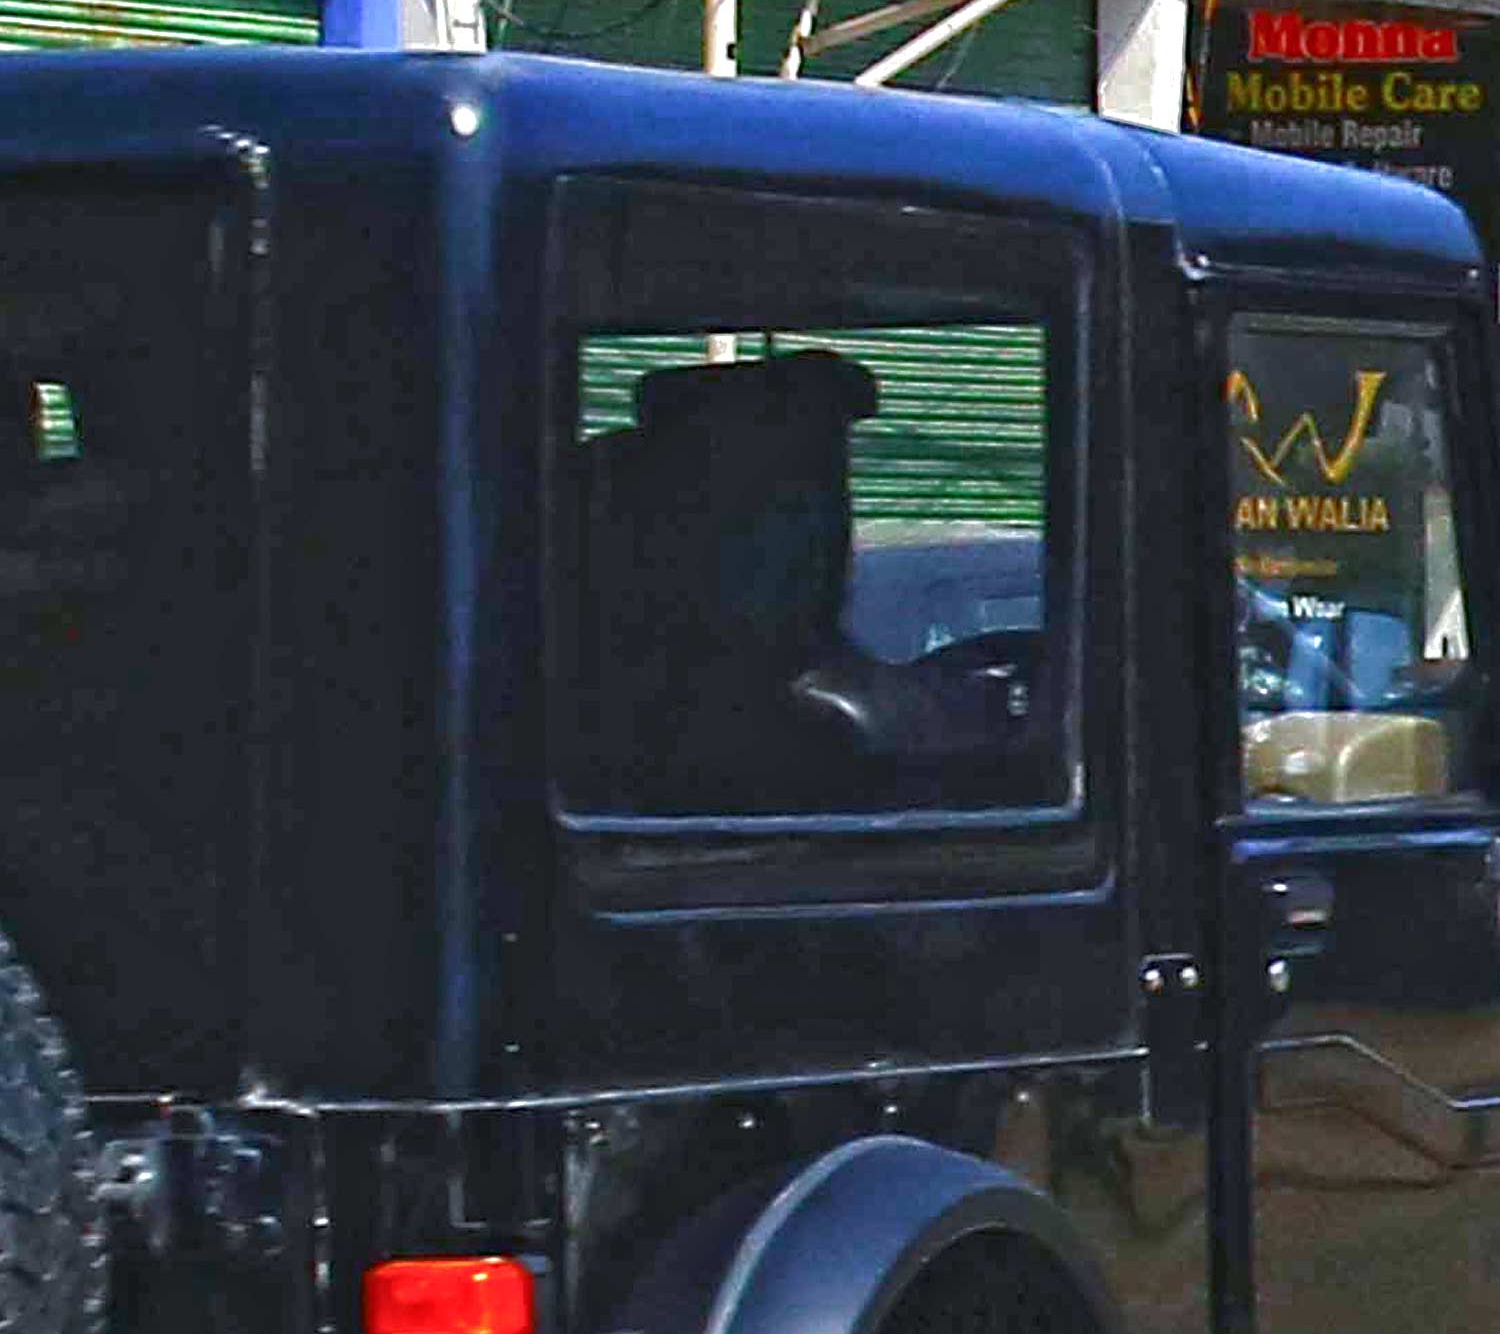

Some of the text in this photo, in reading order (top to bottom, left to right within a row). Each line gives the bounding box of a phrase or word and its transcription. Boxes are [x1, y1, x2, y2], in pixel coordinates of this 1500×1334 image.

[1226, 71, 1483, 112] Mobile Care
[1286, 496, 1390, 532] WALIA
